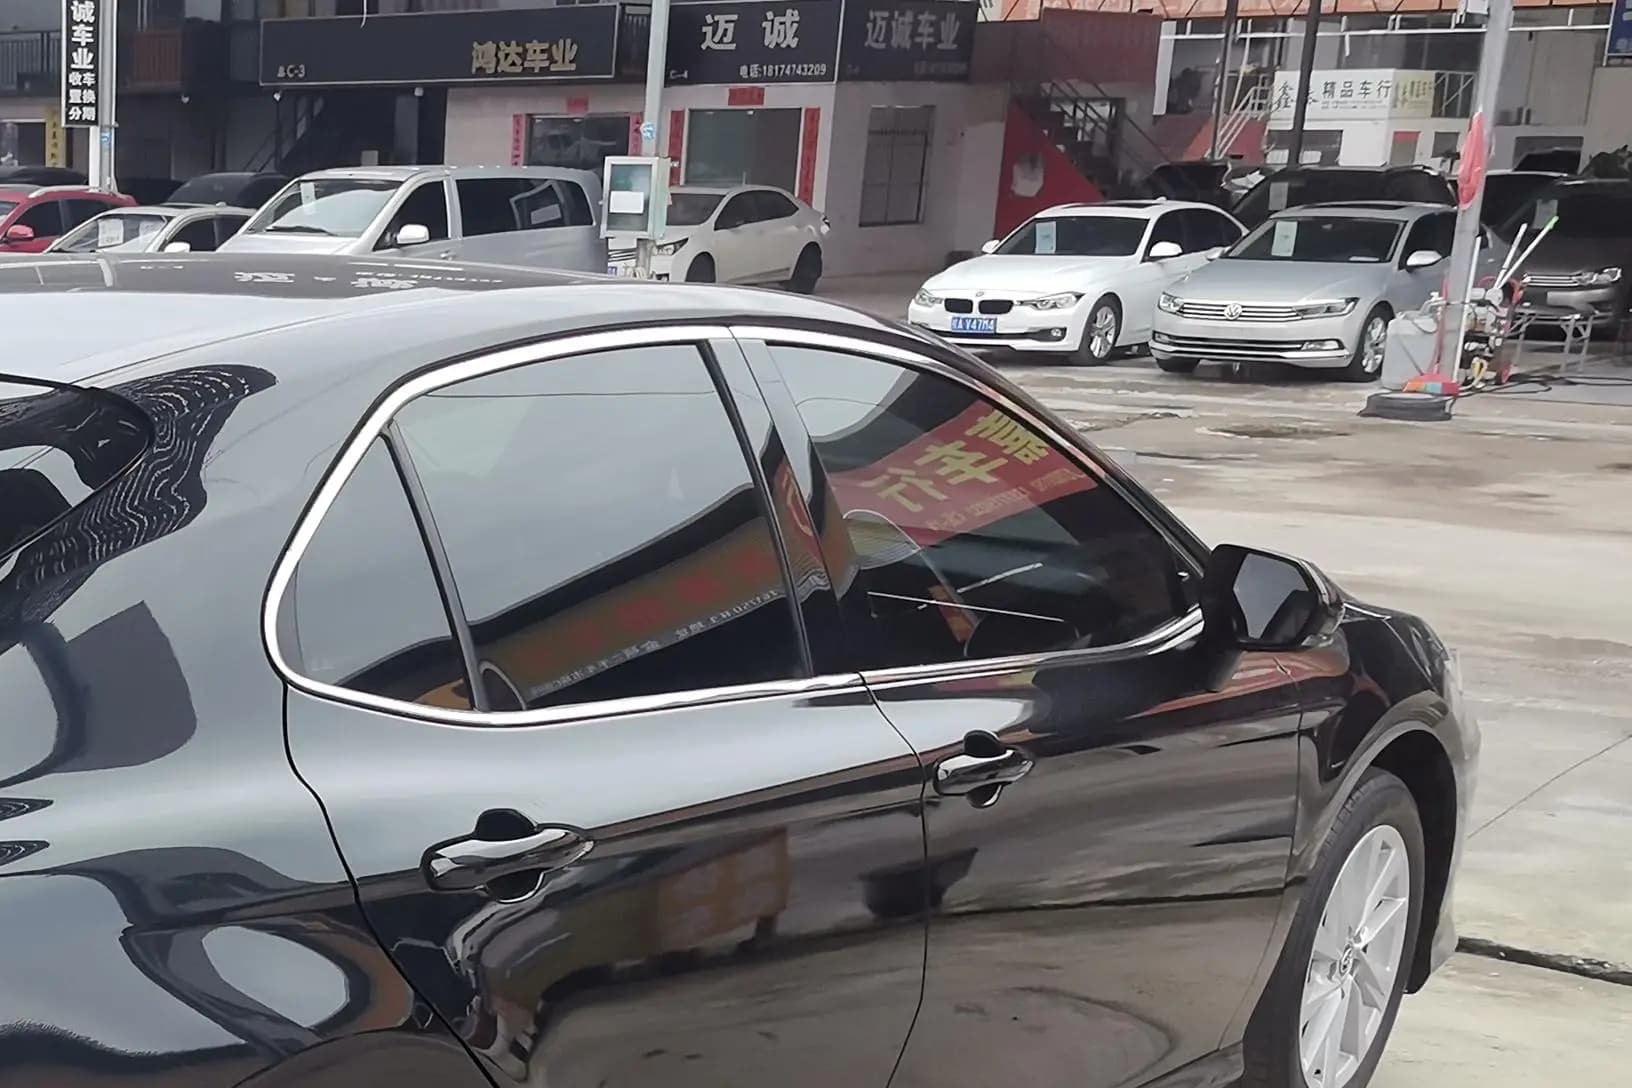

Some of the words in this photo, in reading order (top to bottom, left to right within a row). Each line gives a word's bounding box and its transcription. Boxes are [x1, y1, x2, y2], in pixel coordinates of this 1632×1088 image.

[70, 0, 95, 70] 诚车业
[700, 9, 801, 51] 迈诚
[864, 9, 961, 51] 迈诚车业
[471, 38, 578, 74] 鸿达车业
[68, 71, 96, 87] 收车
[1322, 79, 1393, 99] 精品车行
[68, 106, 96, 121] 分期
